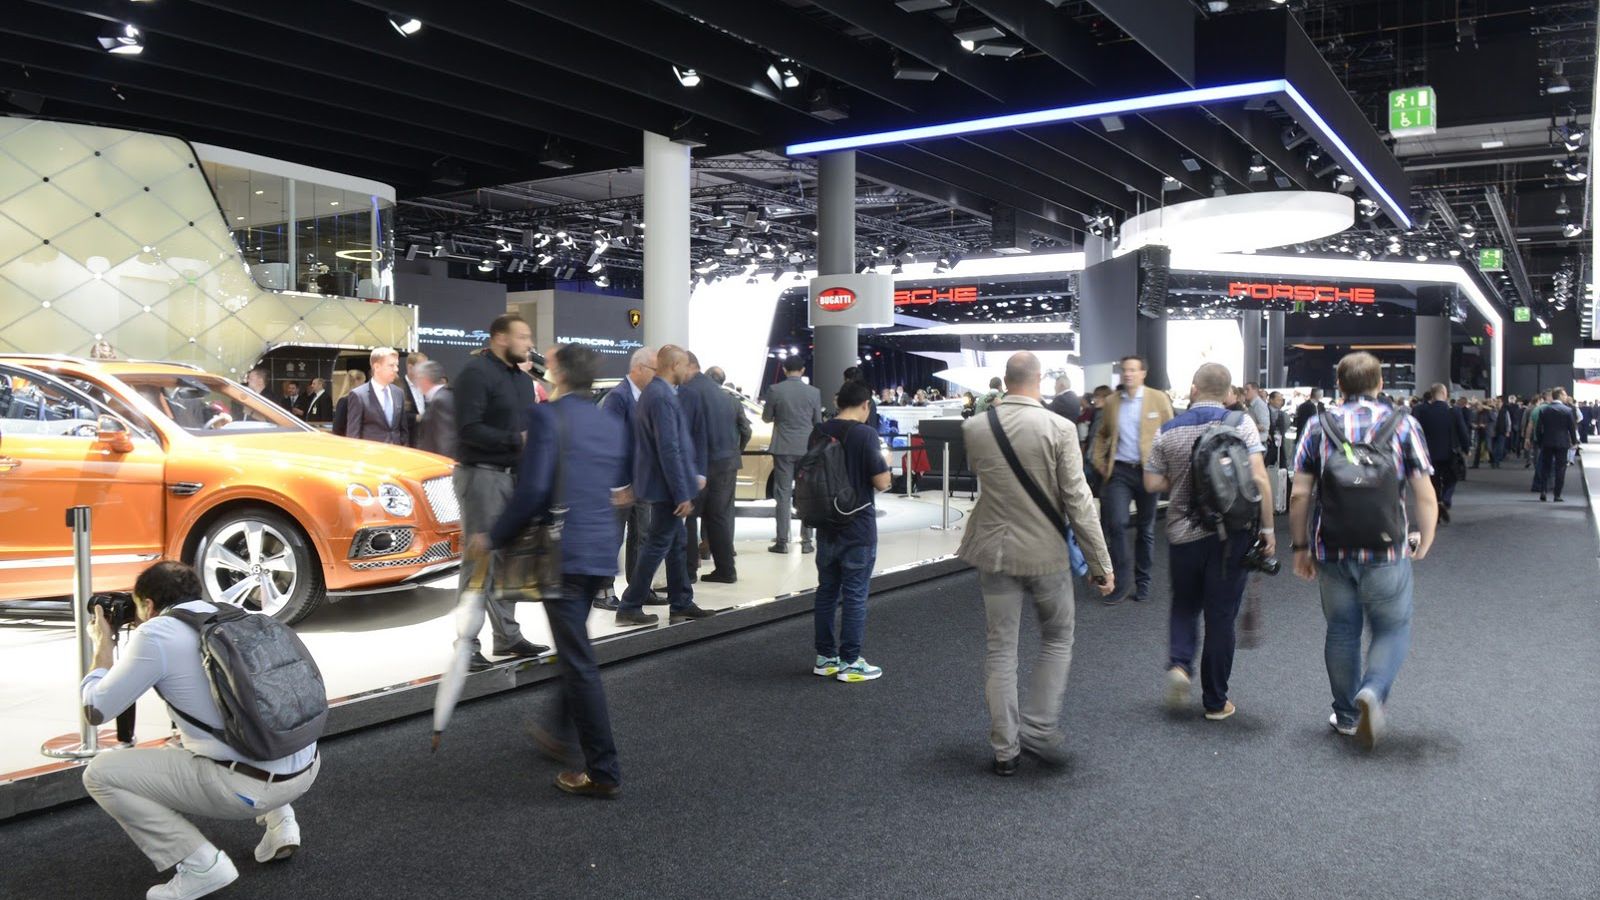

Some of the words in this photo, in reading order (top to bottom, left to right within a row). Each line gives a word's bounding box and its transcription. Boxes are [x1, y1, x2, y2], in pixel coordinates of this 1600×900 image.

[820, 295, 852, 305] BUGATTI
[894, 287, 977, 305] SCHE
[1228, 282, 1375, 303] PORSCHE
